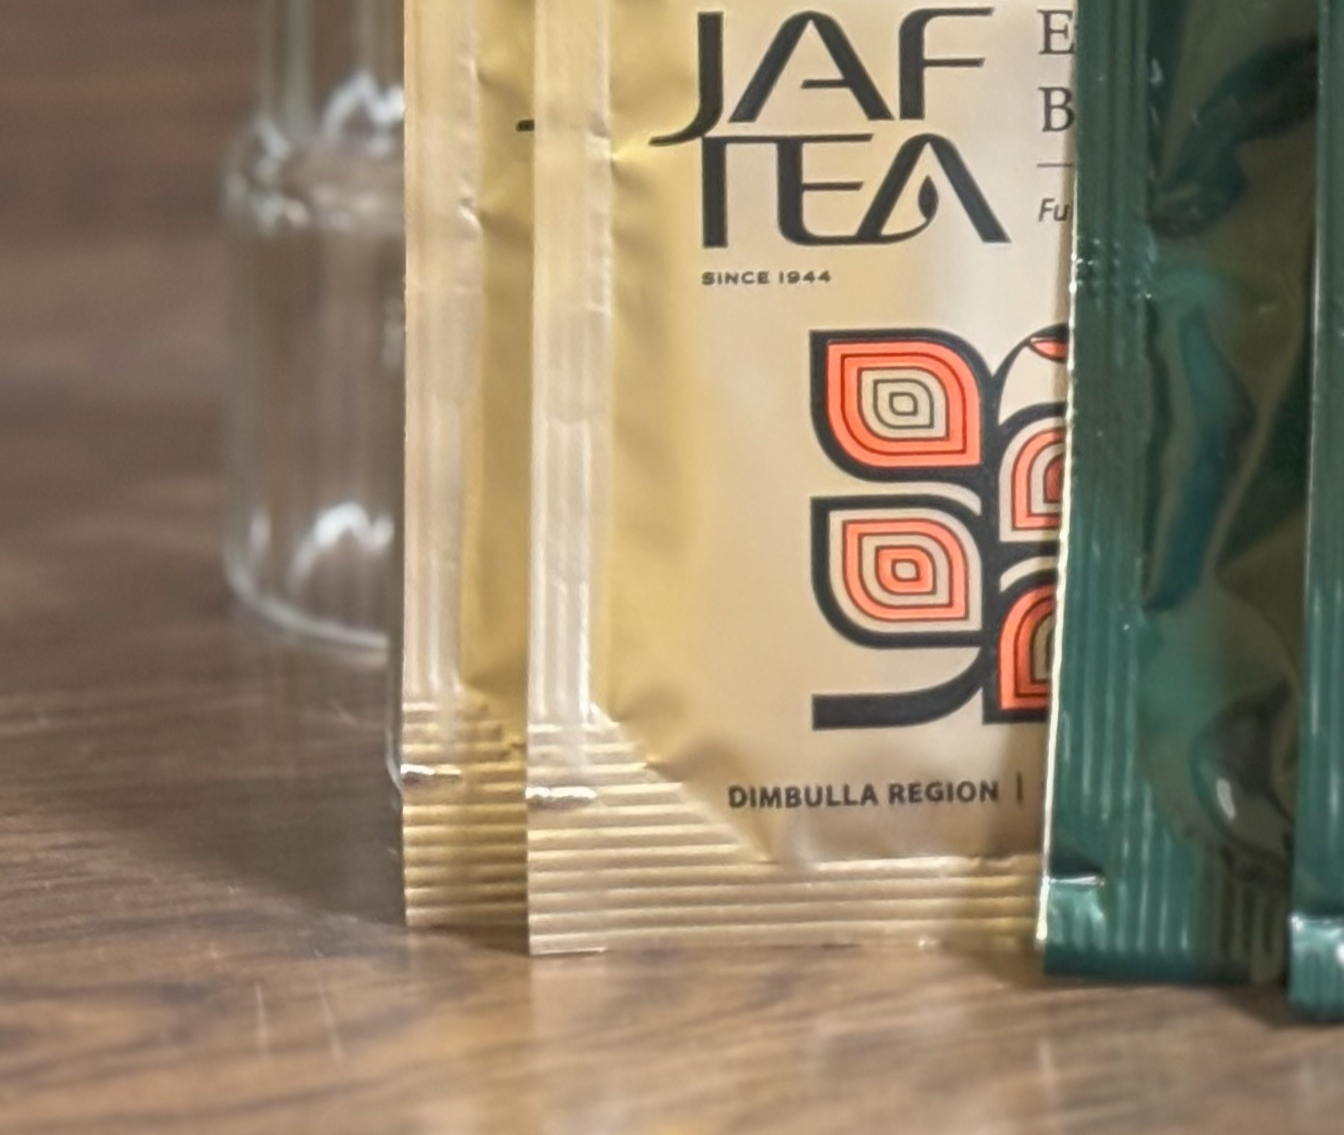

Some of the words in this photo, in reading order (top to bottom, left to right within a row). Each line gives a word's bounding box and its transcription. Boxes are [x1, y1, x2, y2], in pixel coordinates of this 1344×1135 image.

[648, 7, 994, 147] JAF
[701, 132, 1011, 248] TEA
[777, 269, 832, 286] 1944
[727, 783, 879, 809] DIMBULLA
[888, 780, 1000, 806] REGION
